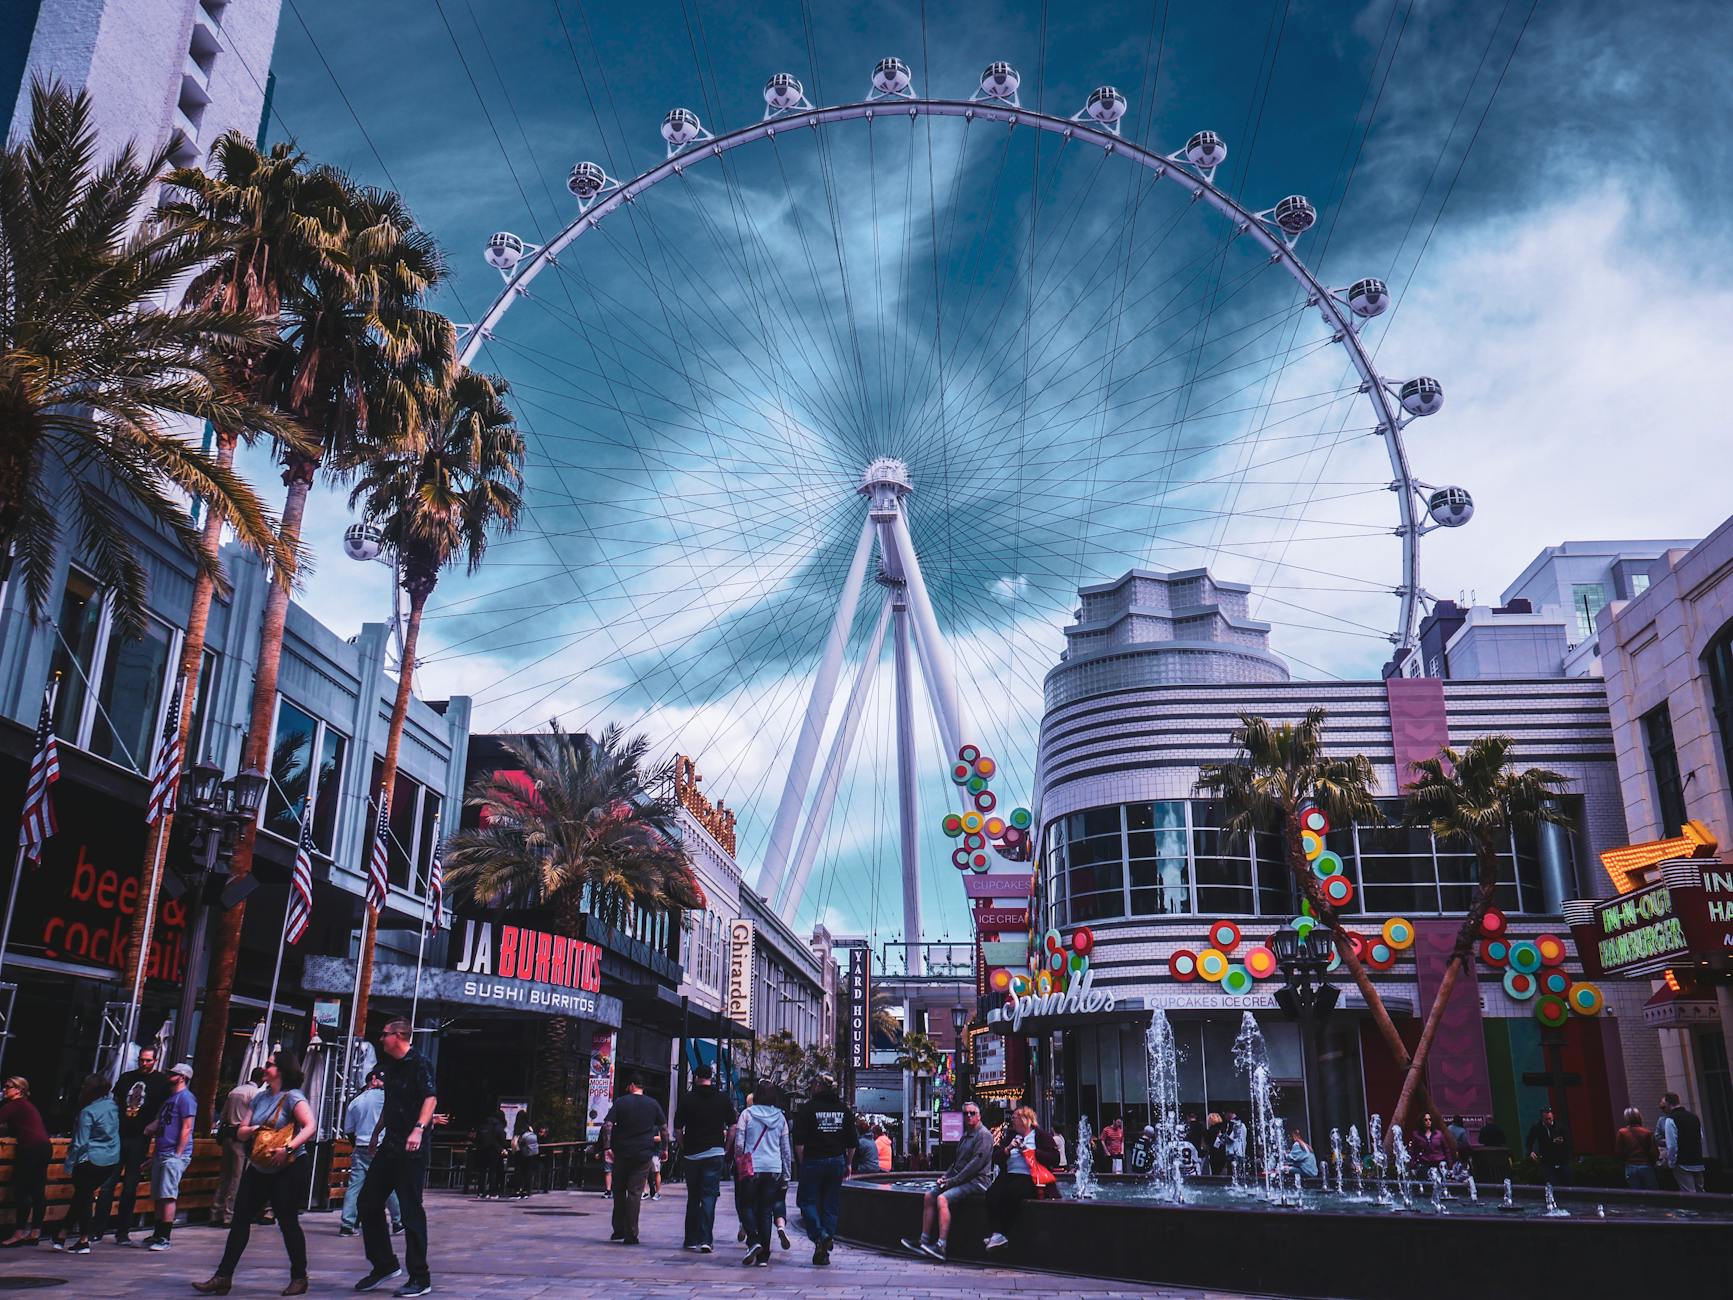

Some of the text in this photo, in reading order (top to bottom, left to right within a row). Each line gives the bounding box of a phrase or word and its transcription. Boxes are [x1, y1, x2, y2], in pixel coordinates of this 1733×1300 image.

[71, 845, 138, 914] bee
[973, 879, 1031, 890] CUPCAKES
[979, 914, 1027, 924] ICE CREA
[1602, 887, 1672, 934] IN-N-OUT
[43, 916, 187, 982] cockail
[456, 919, 602, 993] JA BURRITOS
[730, 924, 749, 1021] Ghirardell
[464, 981, 595, 1013] SUSHI BURRITOS
[853, 951, 863, 1068] YARD HOUSE
[1002, 968, 1115, 1032] Sprinkles
[1150, 996, 1279, 1008] CUPCAKES ICE CREA
[589, 1088, 609, 1097] POPS
